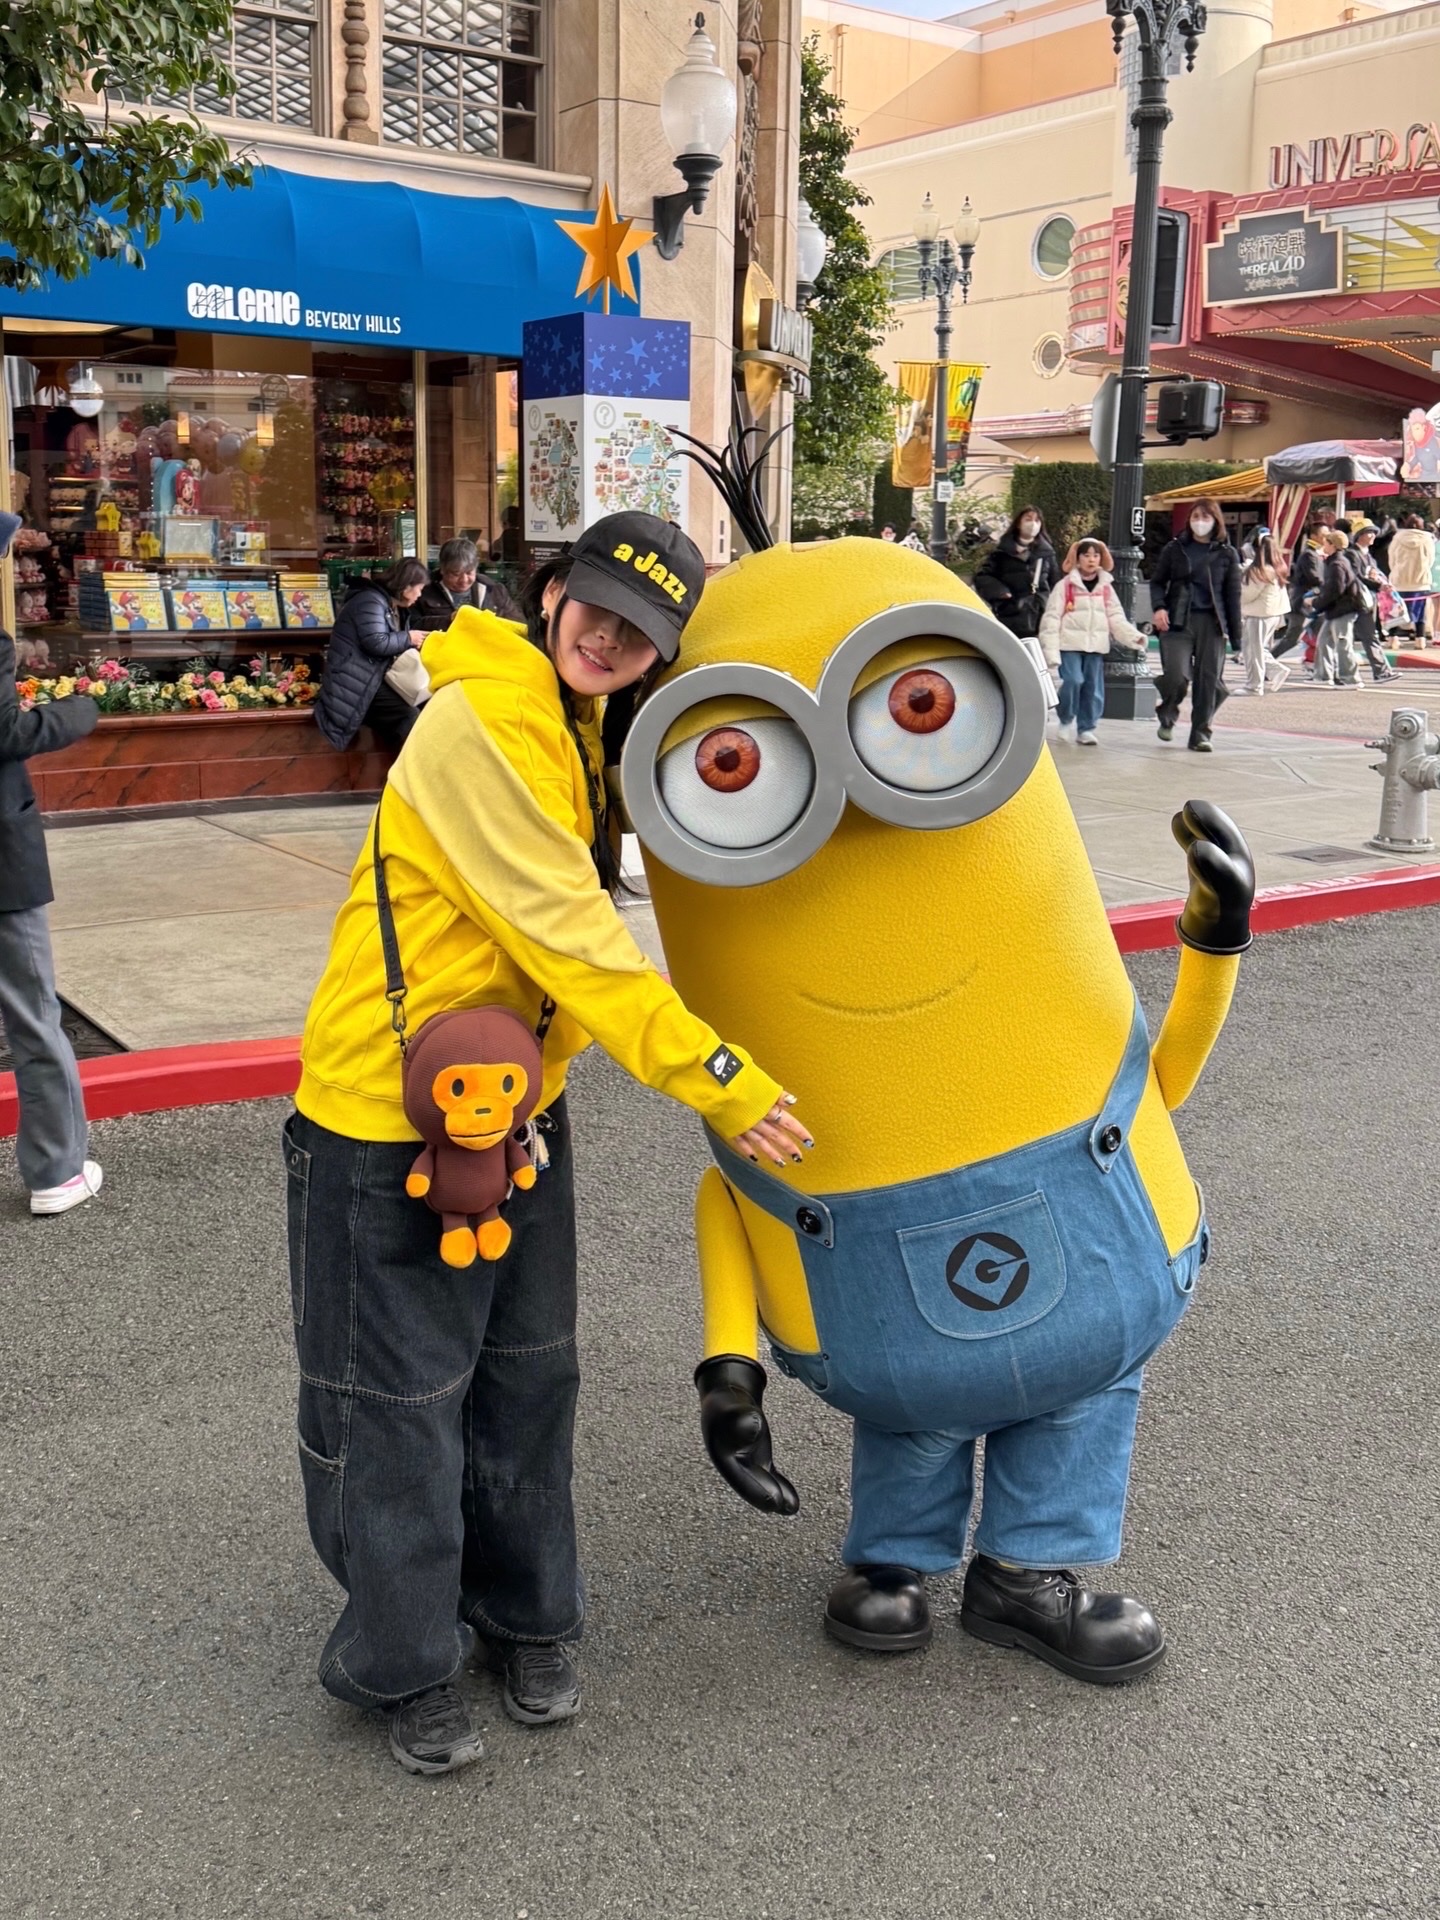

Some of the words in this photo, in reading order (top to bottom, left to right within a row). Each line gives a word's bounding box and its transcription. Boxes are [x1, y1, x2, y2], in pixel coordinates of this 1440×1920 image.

[305, 310, 361, 331] BEVERLY
[365, 315, 402, 335] HILLS
[613, 543, 634, 562] a
[634, 551, 688, 604] Jazz
[721, 1061, 737, 1079] AIR
